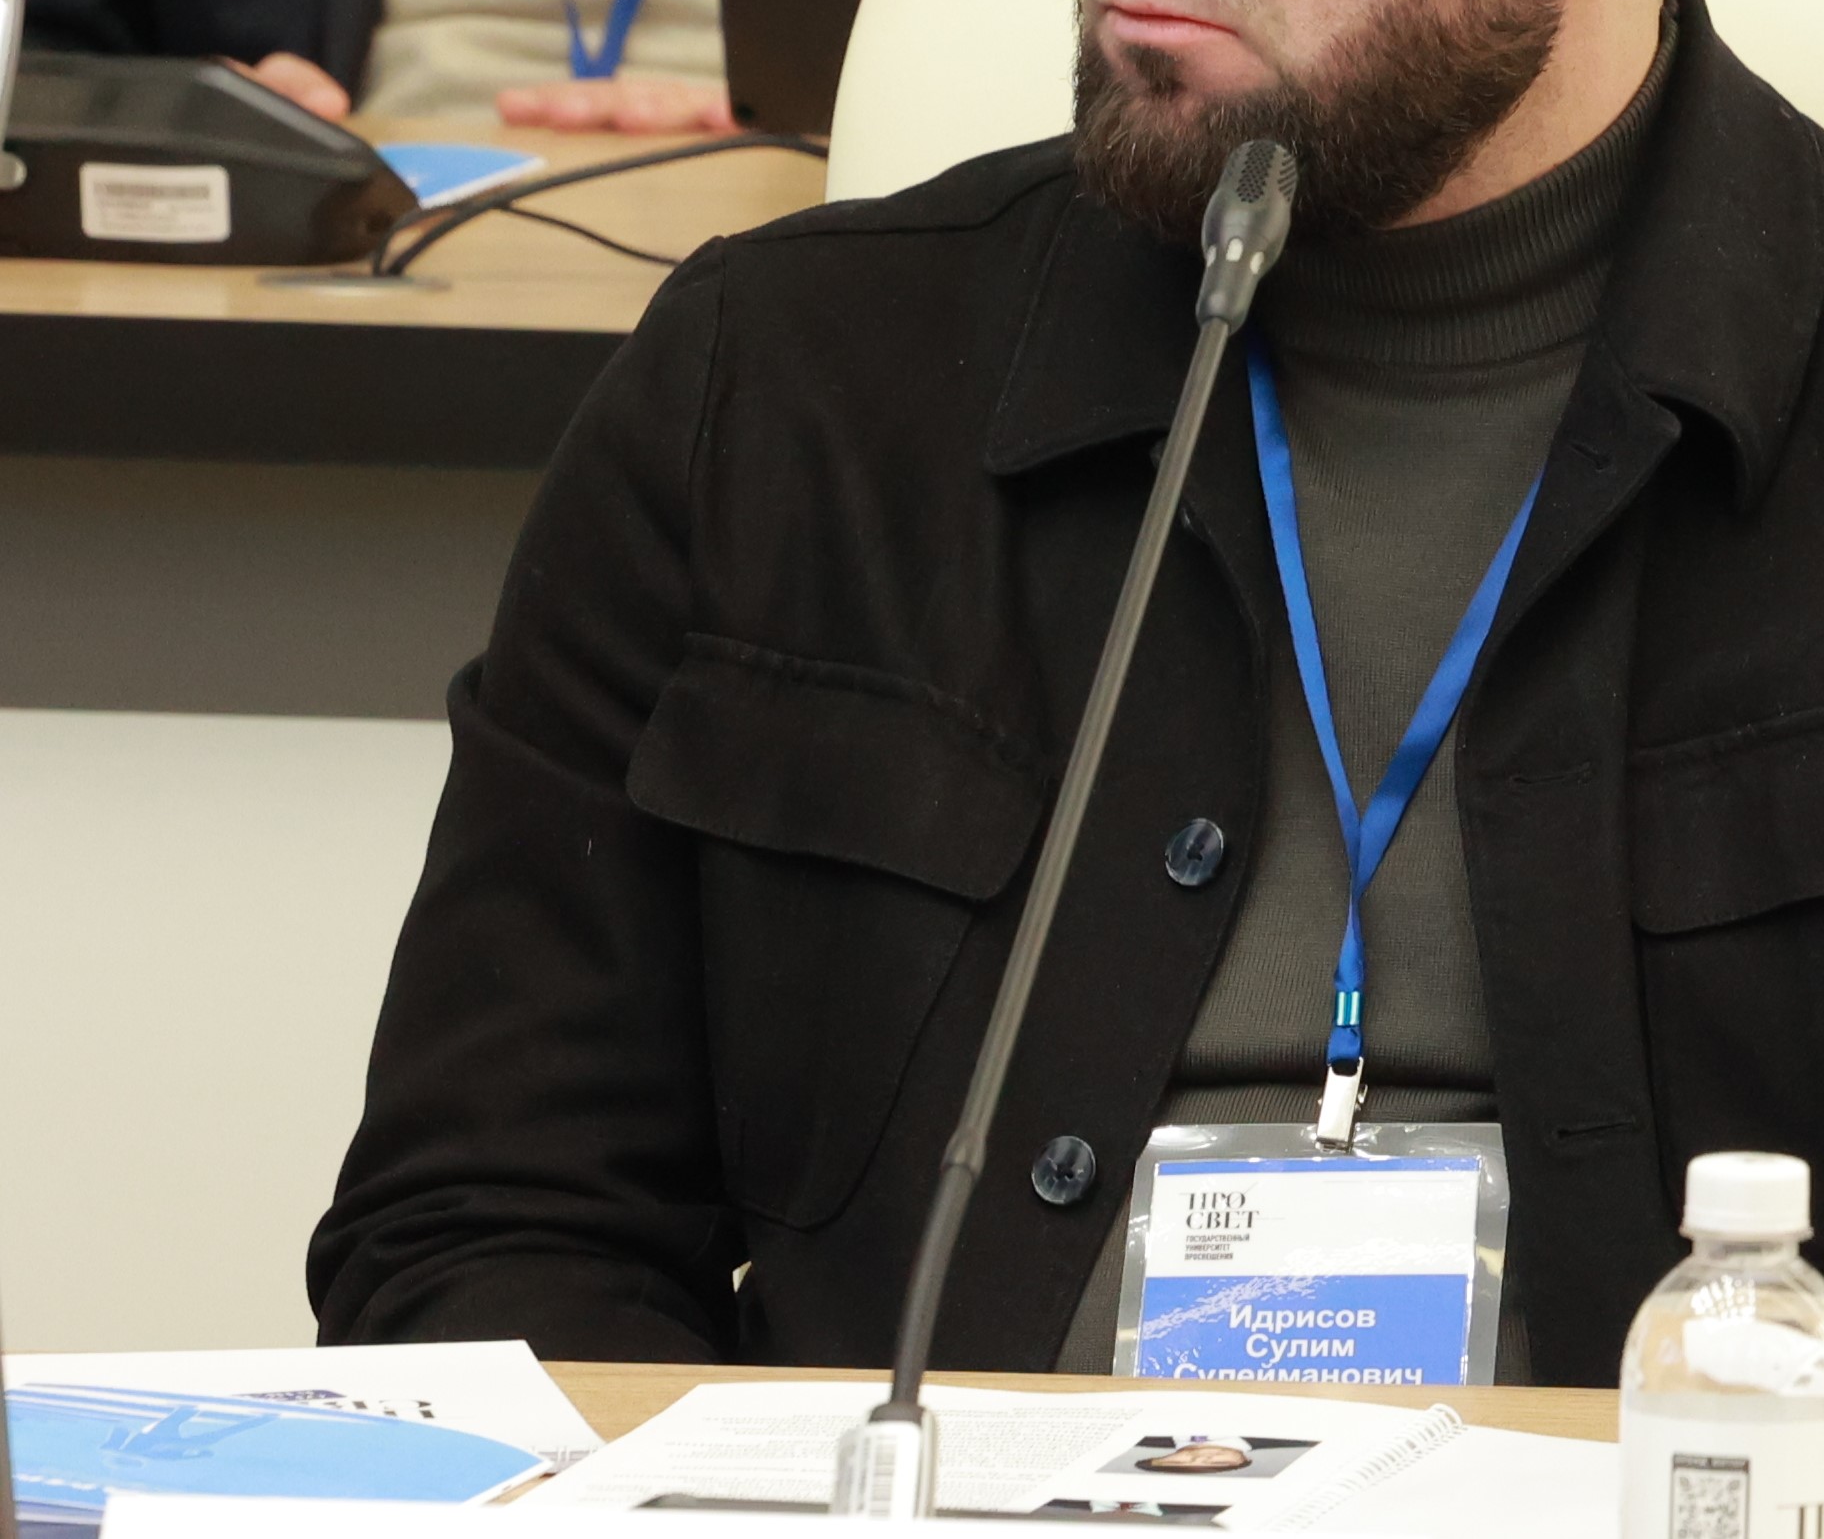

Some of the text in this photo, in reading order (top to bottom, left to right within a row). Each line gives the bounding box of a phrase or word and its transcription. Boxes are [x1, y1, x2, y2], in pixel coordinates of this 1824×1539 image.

[1188, 1191, 1247, 1211] ПРО
[1185, 1210, 1260, 1230] СВЕТ
[1185, 1243, 1231, 1252] УНИВЕРСИТЕТ
[1186, 1233, 1250, 1243] ГОСУДАРСТВЕННЫЙ
[1184, 1252, 1234, 1261] ПРОСВЕЩЕНИЯ
[1228, 1305, 1377, 1334] Идрисов
[1245, 1333, 1354, 1364] Сулим
